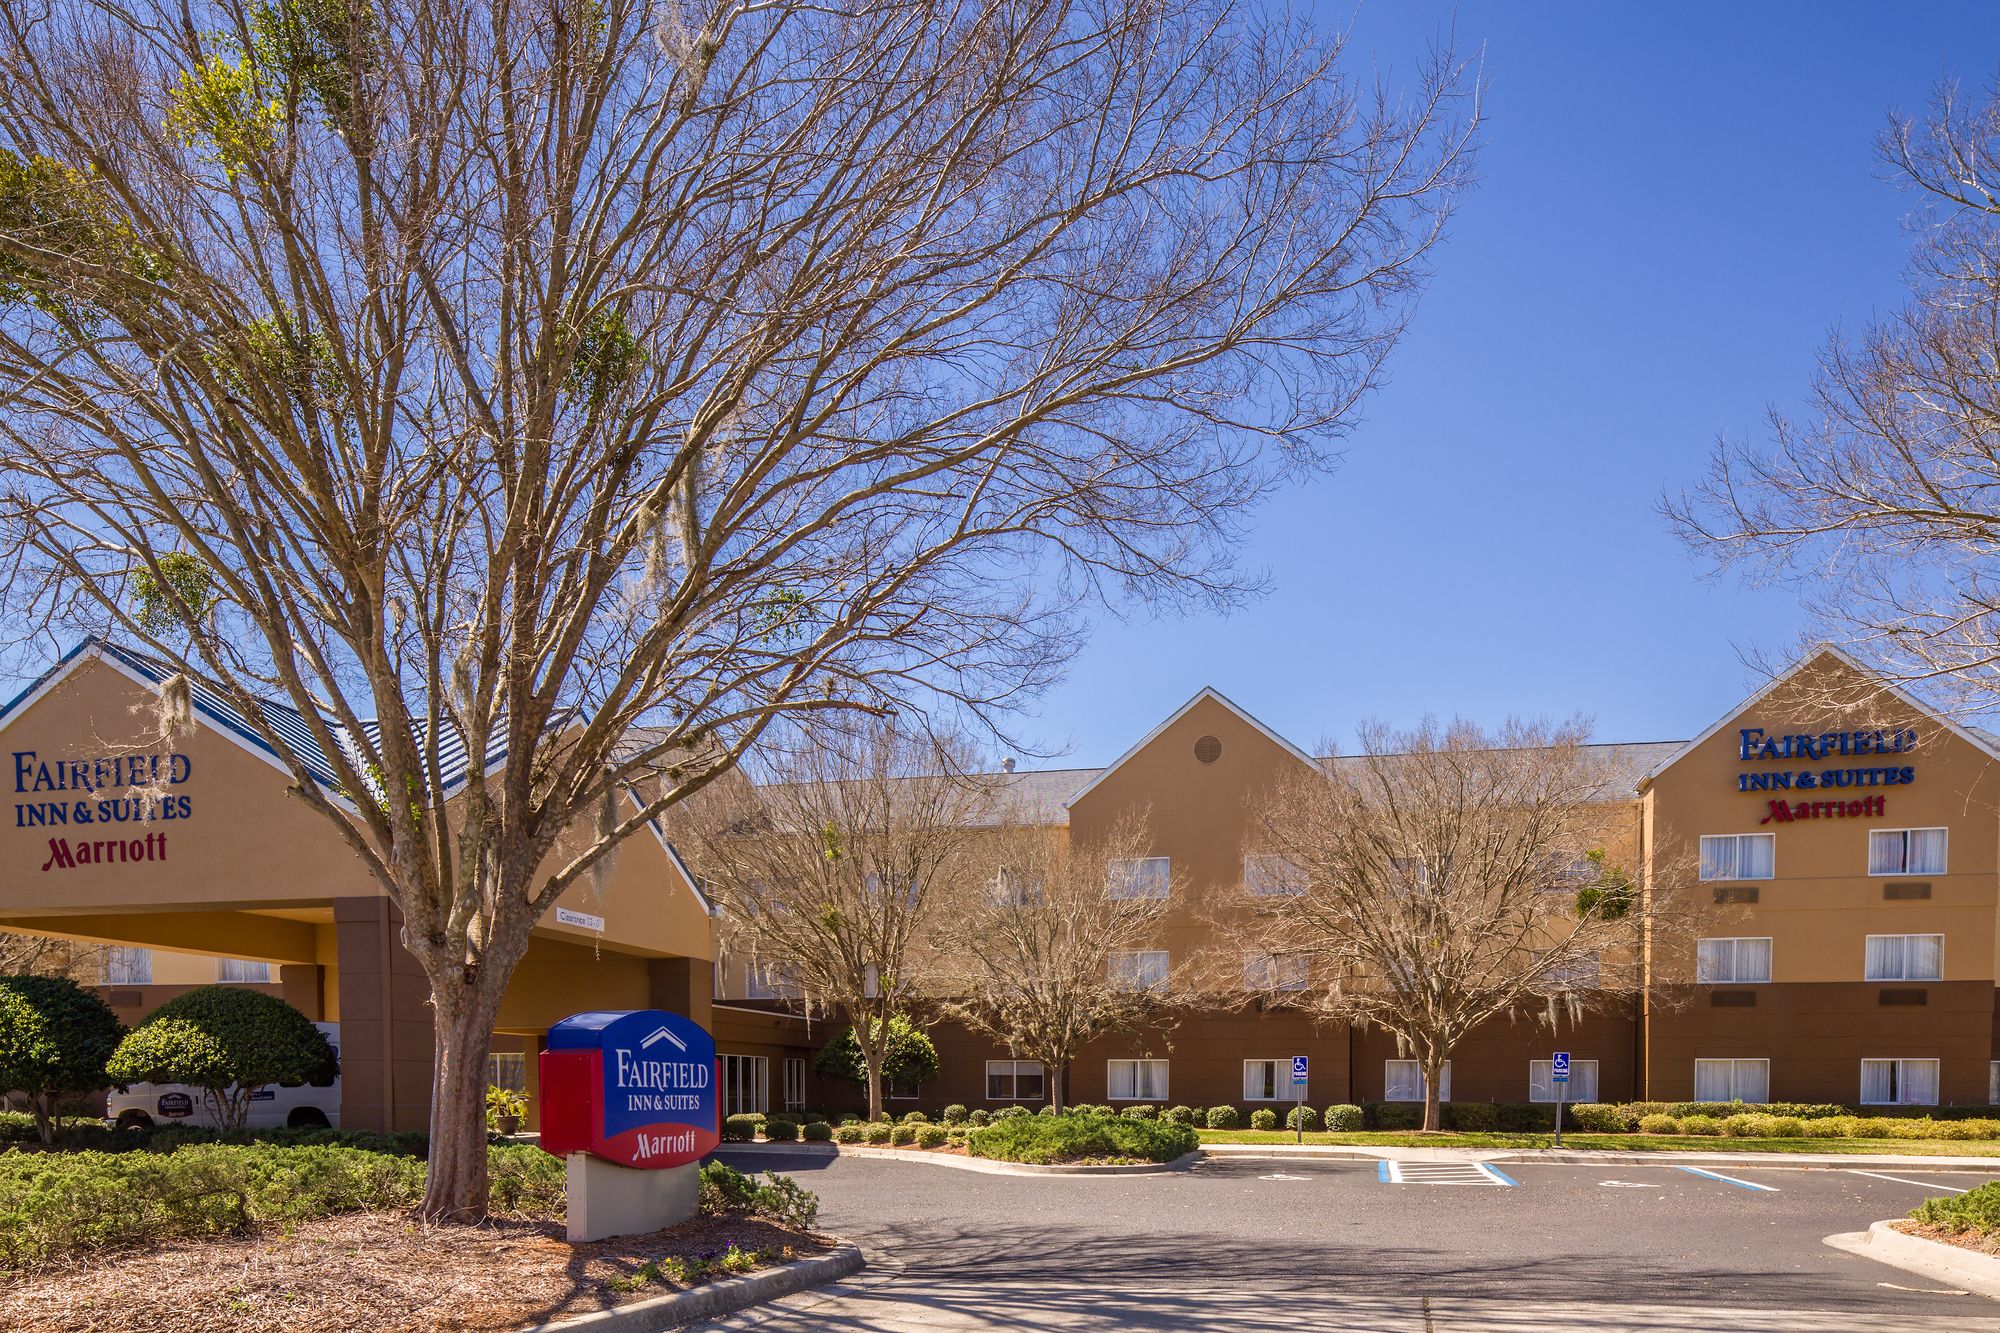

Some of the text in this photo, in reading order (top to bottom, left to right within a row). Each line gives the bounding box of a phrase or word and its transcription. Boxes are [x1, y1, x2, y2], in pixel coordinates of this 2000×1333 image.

[1738, 728, 1917, 761] FAIRFIELD
[1738, 766, 1915, 792] INN & SUITES
[14, 802, 69, 827] INN
[72, 801, 95, 825] &
[1760, 795, 1887, 825] Marriott
[41, 832, 168, 872] Marriott
[615, 1049, 709, 1092] FAIRFIELD
[628, 1094, 700, 1111] INN & SUITES
[632, 1130, 696, 1162] Marriott
